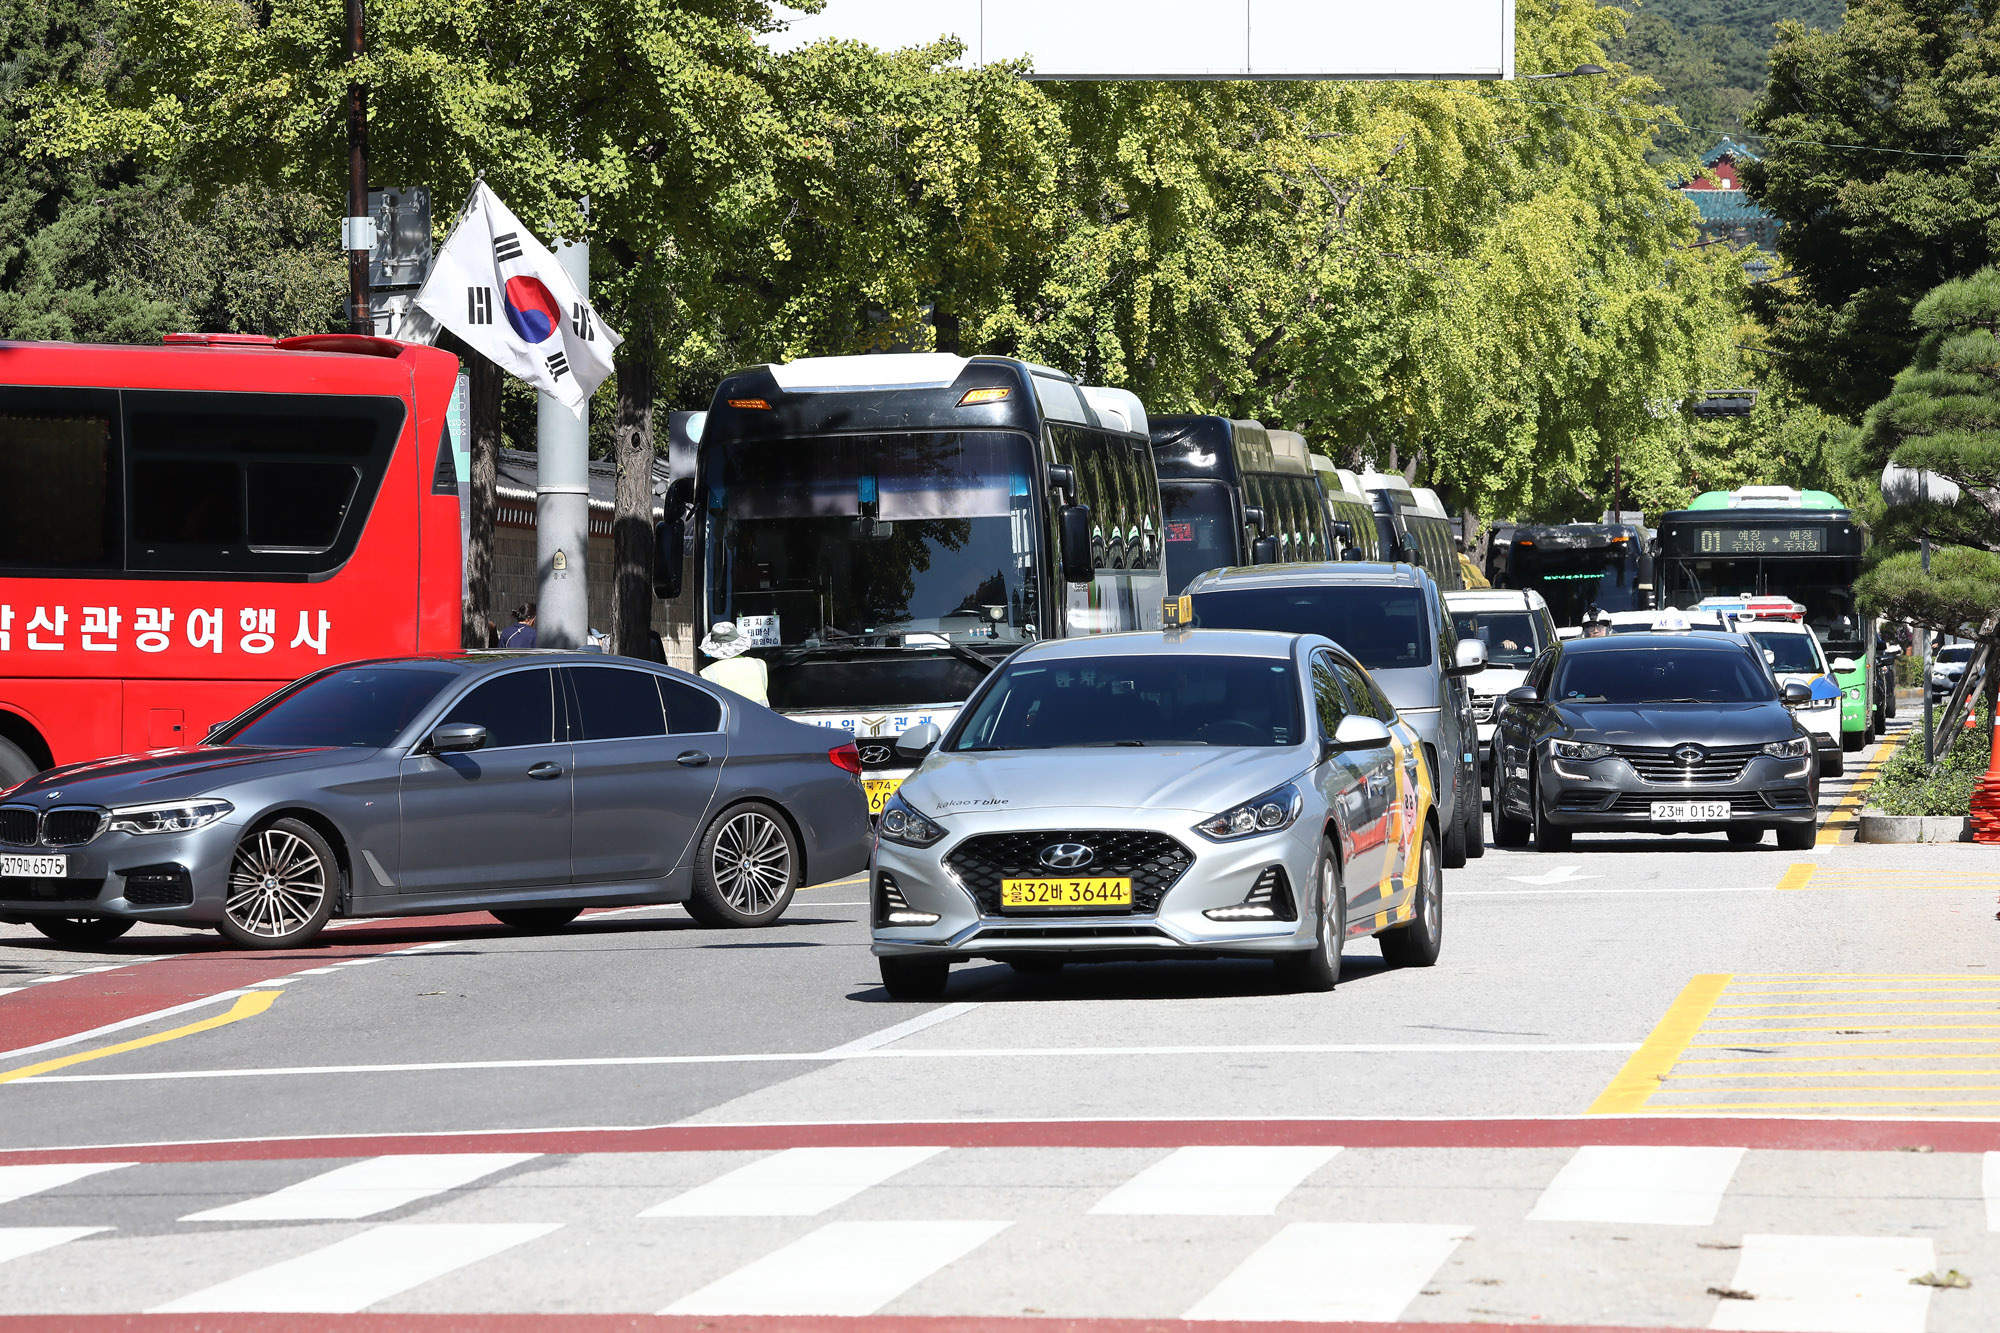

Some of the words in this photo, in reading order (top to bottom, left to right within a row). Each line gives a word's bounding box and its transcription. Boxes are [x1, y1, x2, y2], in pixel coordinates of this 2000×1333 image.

[1701, 530, 1720, 552] 01
[1732, 541, 1766, 551] 주차장
[1784, 541, 1818, 551] 주차장
[877, 781, 891, 790] 74
[936, 800, 971, 810] kakao
[982, 798, 1009, 806] blue
[1658, 805, 1684, 818] 23버
[1690, 804, 1724, 818] 0152
[4, 857, 31, 874] 379마
[33, 858, 62, 875] 6575
[1069, 881, 1123, 902] 3644
